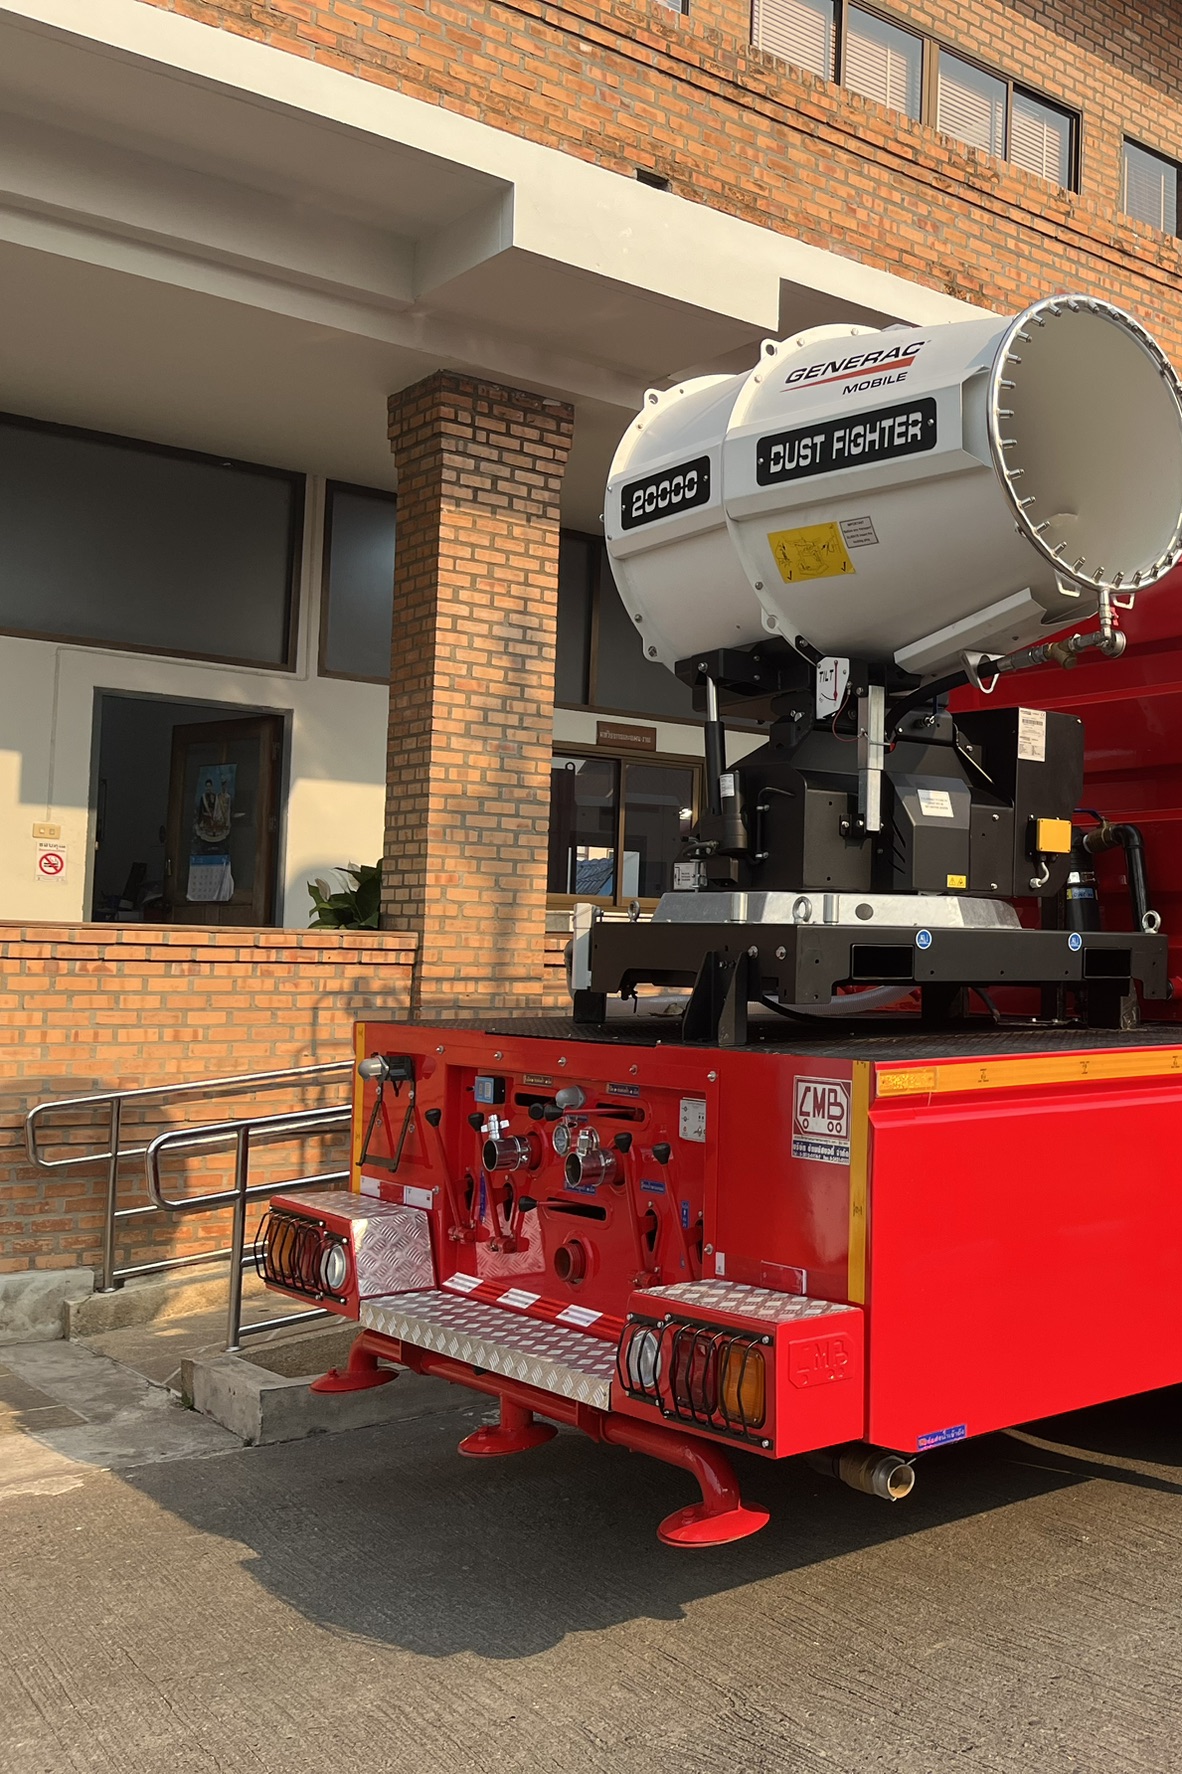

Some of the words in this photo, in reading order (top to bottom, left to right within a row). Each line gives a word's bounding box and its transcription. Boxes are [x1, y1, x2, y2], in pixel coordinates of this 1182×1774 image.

[785, 341, 926, 385] GENERAC
[842, 371, 909, 396] MOBILE
[769, 434, 826, 474] DUST
[832, 411, 923, 460] FIGHTER
[631, 469, 698, 518] 20000
[819, 668, 834, 683] TILT
